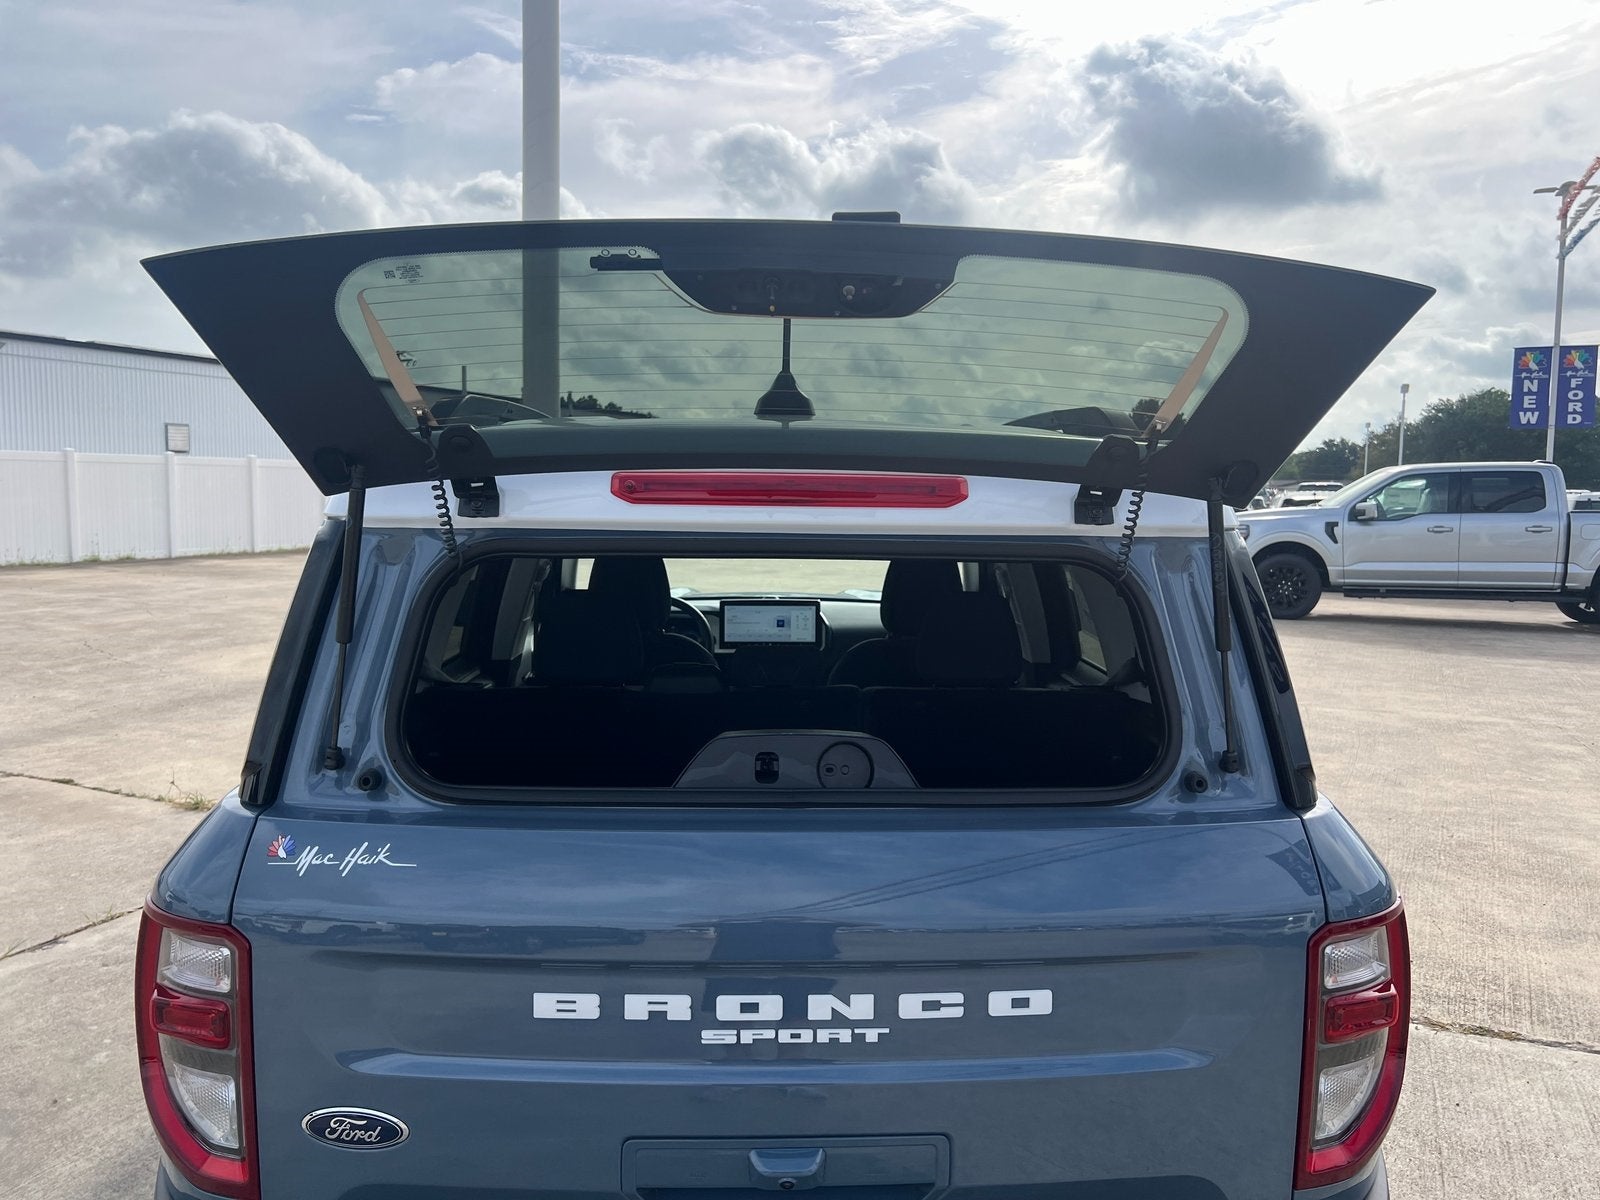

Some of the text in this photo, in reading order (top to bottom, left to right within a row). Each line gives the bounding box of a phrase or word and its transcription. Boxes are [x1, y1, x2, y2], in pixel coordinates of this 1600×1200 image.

[1519, 379, 1540, 425] NEW
[1567, 378, 1584, 425] FORD
[268, 842, 417, 877] Mac Haik
[533, 989, 1053, 1021] BRONCO
[701, 1027, 890, 1044] SPORT
[325, 1117, 381, 1142] Ford
